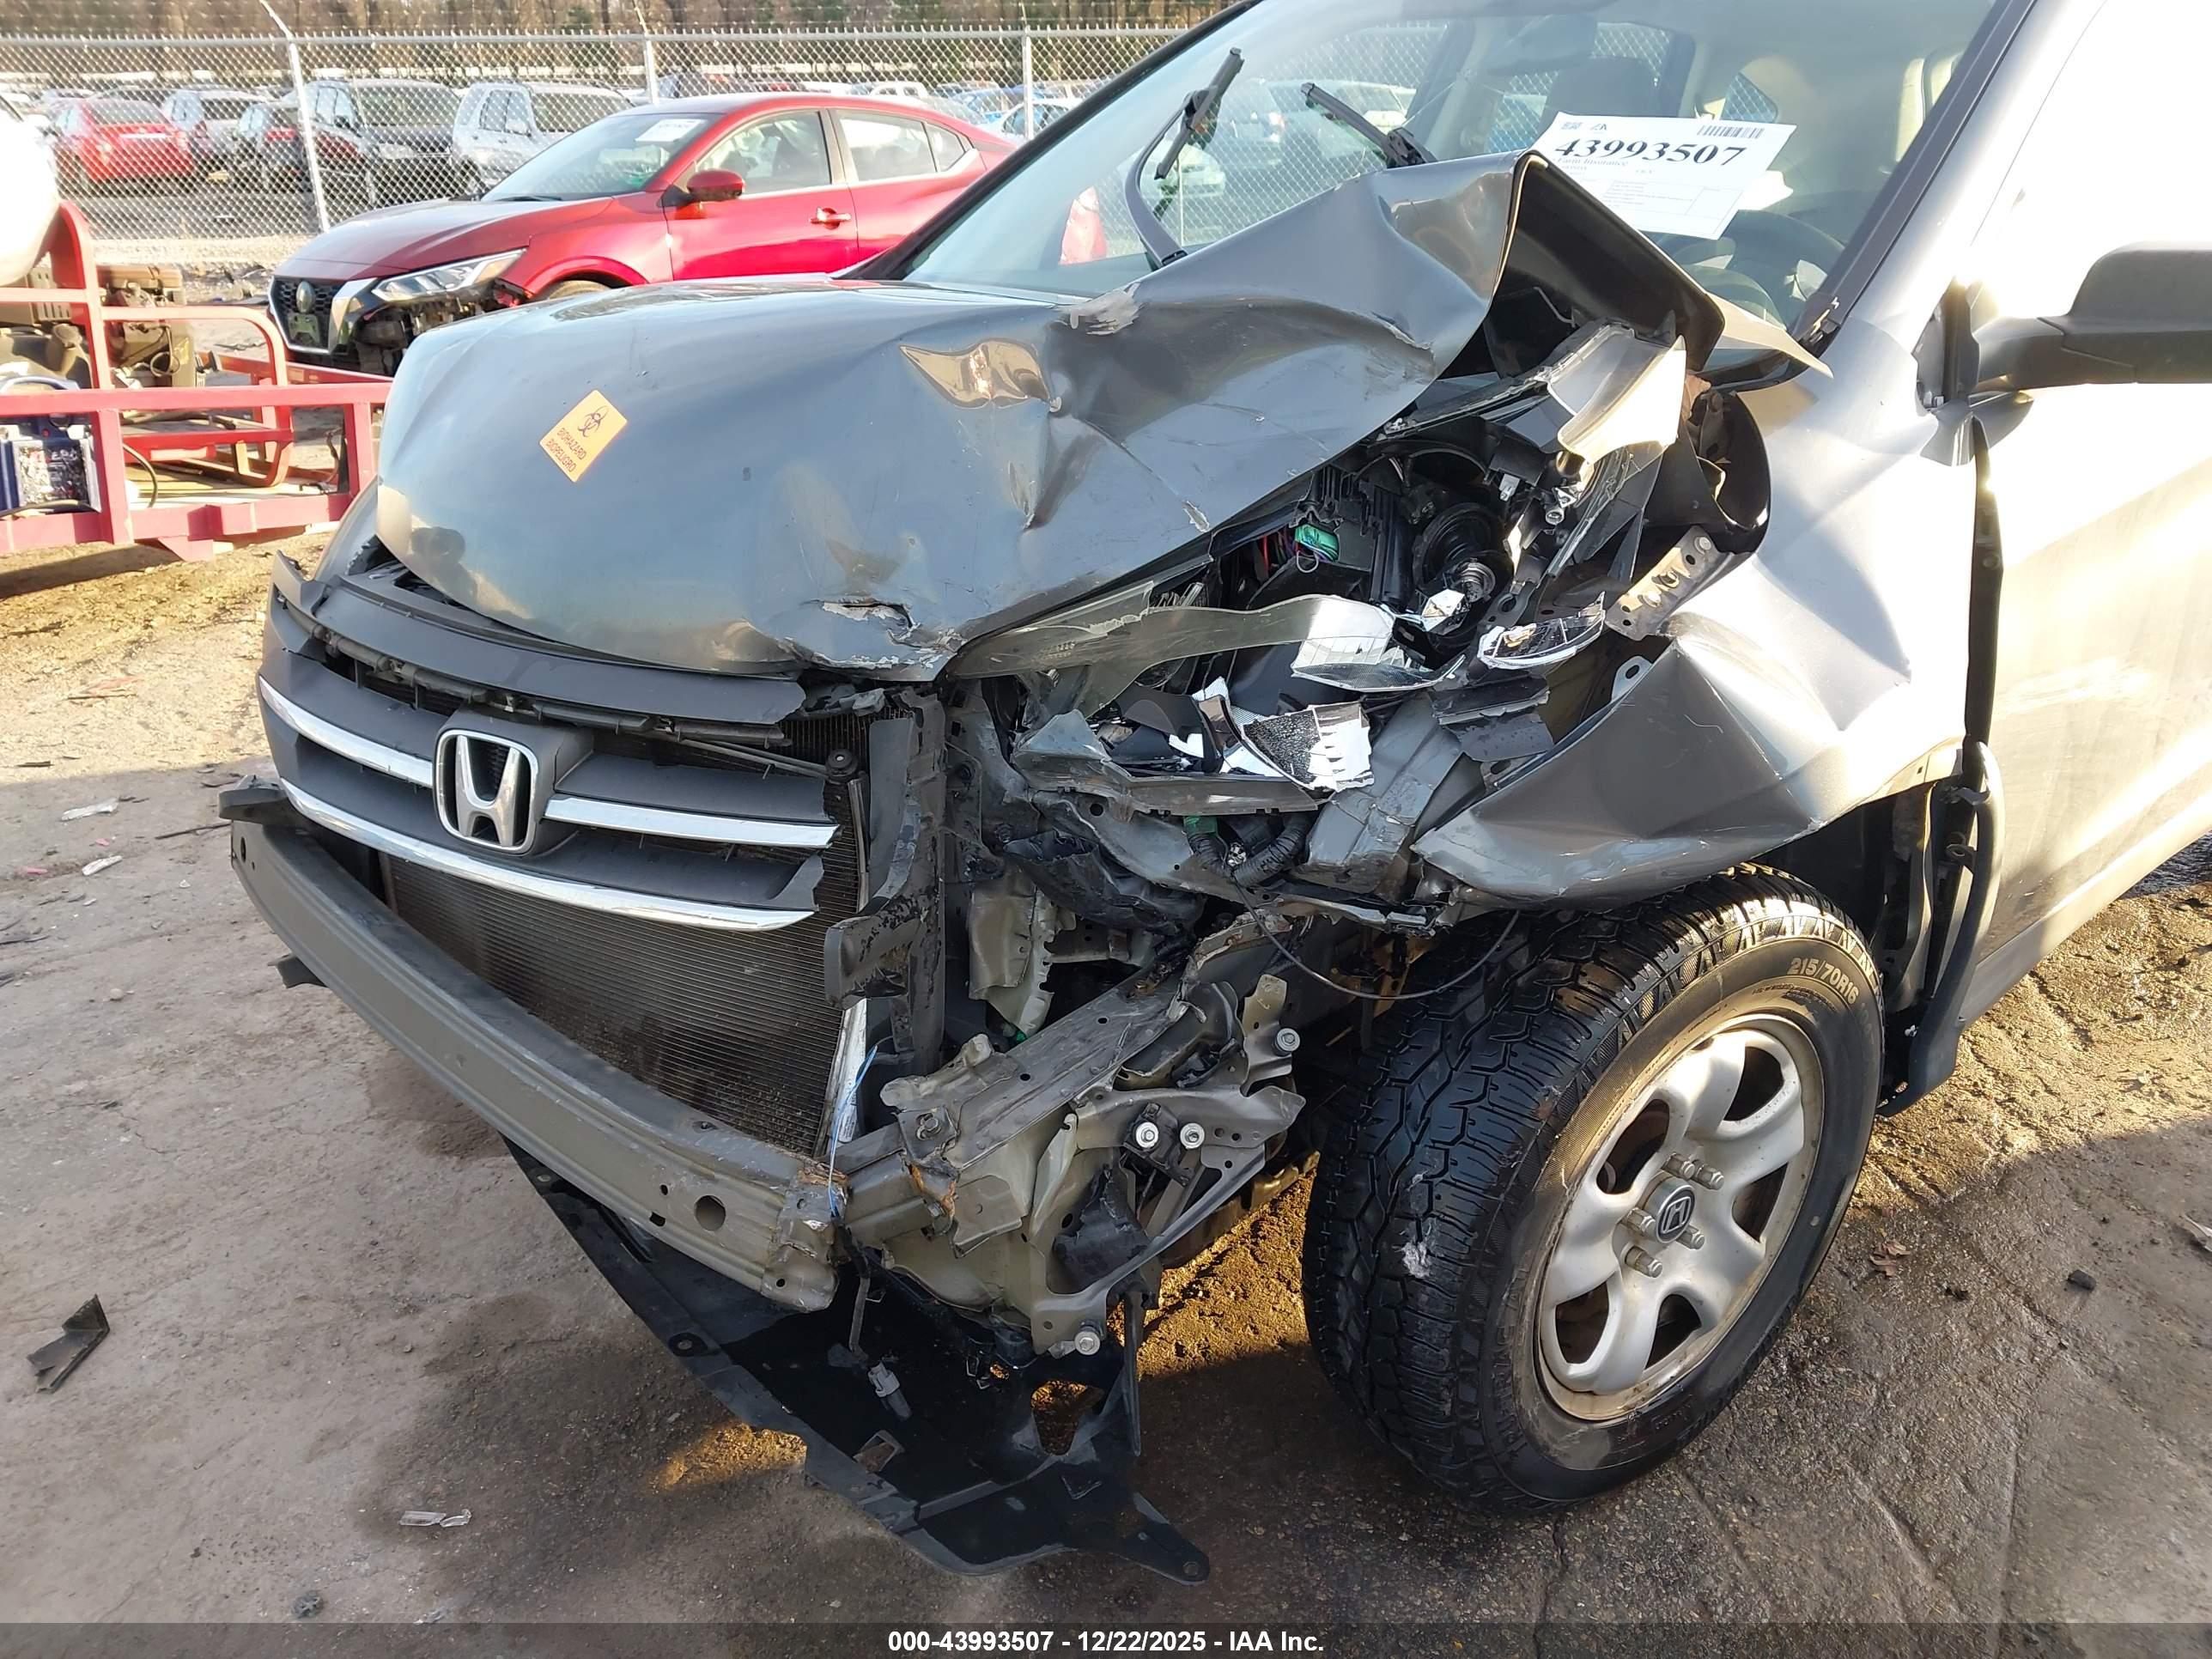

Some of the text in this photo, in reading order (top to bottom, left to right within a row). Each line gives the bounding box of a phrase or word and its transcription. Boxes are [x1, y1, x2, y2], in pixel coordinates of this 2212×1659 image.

[1555, 138, 1747, 166] 43993507
[546, 438, 577, 472] BIOPELIGRO
[557, 428, 587, 460] BIOHAZARD
[1787, 957, 1860, 1005] 215/70R16
